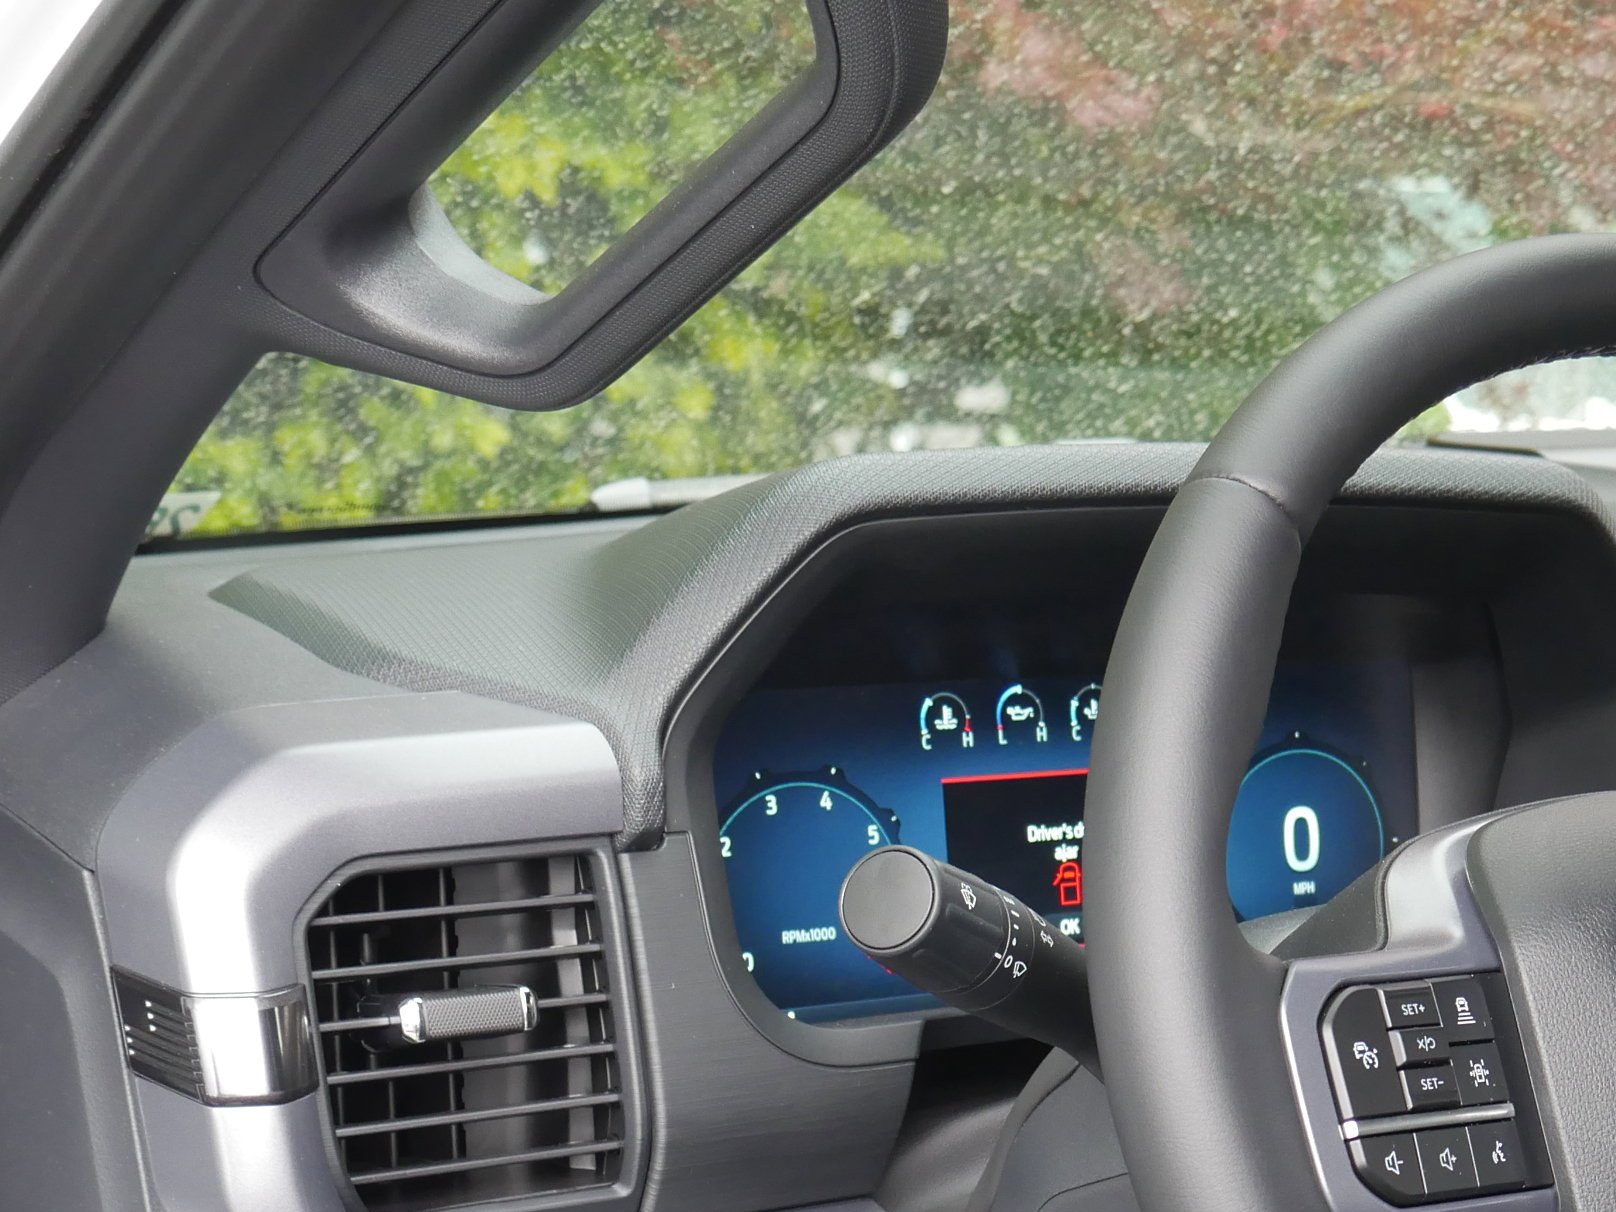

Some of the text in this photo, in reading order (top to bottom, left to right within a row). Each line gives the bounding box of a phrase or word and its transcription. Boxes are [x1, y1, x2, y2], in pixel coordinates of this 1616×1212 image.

[765, 794, 778, 815] 3
[819, 790, 833, 811] 4
[867, 824, 880, 845] 5
[1026, 822, 1073, 842] Driver's
[1283, 805, 1321, 873] 0
[719, 836, 732, 857] 2
[1054, 844, 1079, 862] ajar
[1292, 881, 1316, 895] MPH
[781, 926, 837, 945] RPMx1000
[1060, 918, 1081, 936] OK
[1401, 1003, 1425, 1016] SET+
